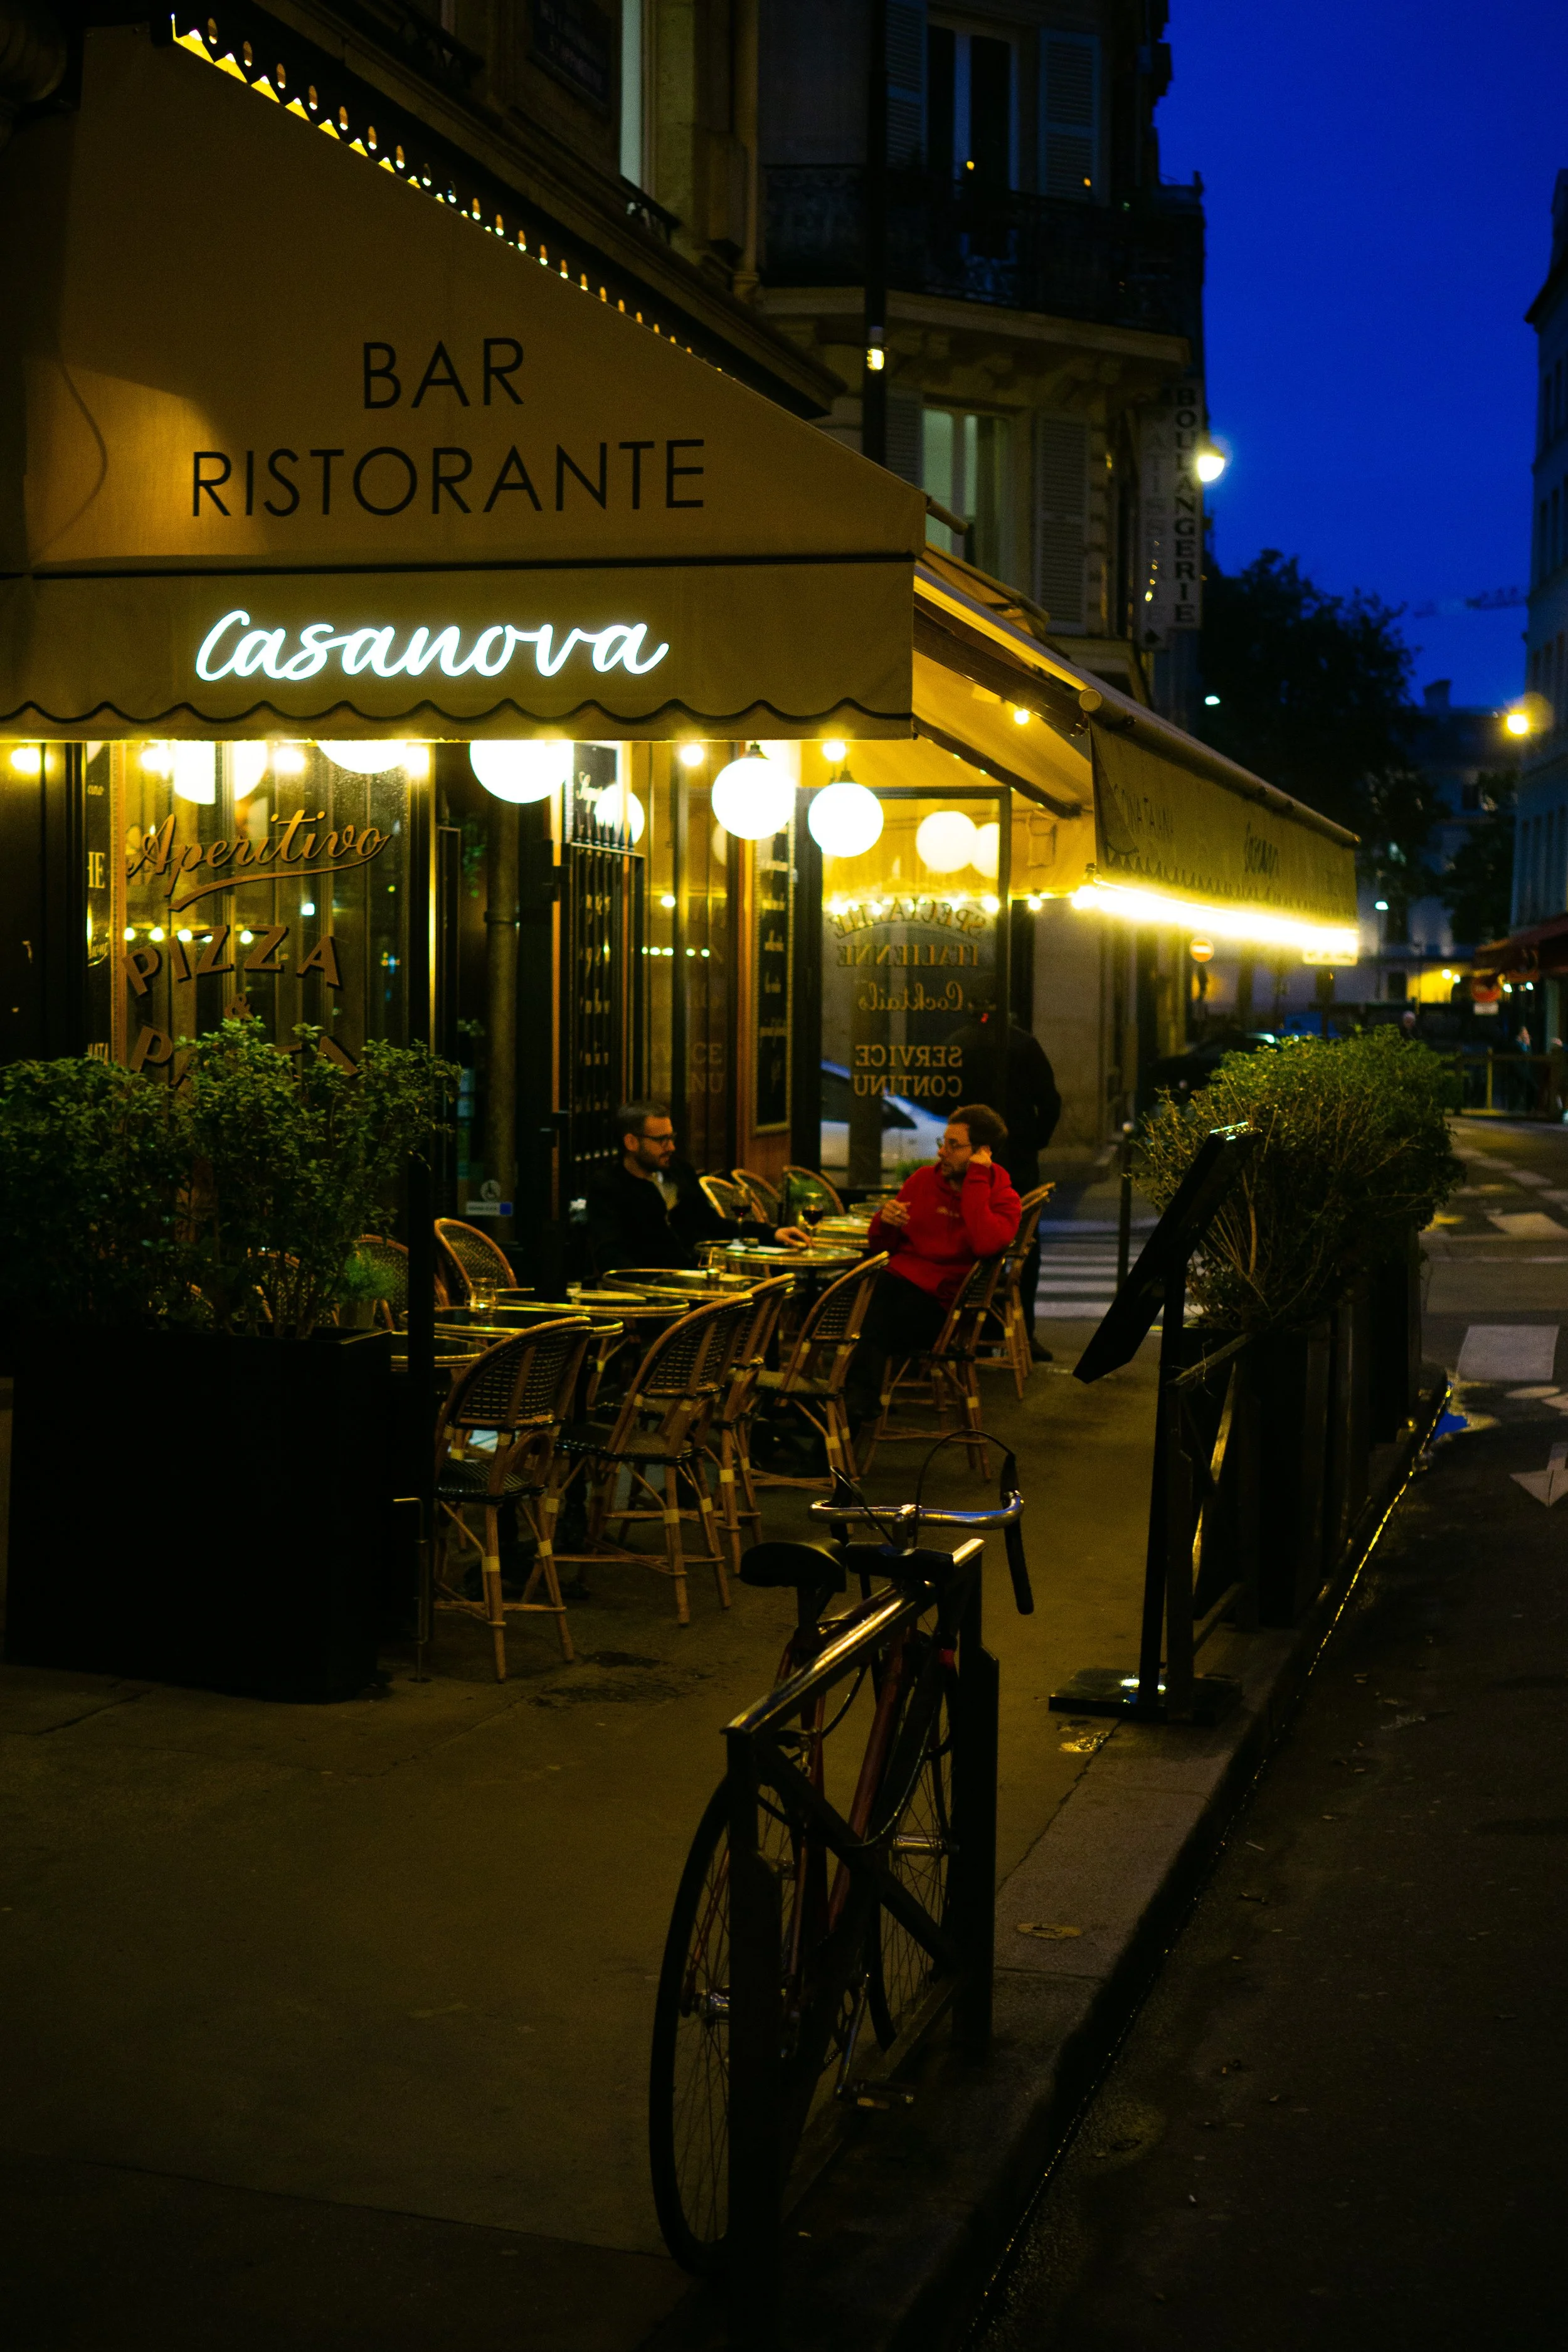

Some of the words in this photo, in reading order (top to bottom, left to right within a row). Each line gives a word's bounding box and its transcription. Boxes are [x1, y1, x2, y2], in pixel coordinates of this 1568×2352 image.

[363, 337, 524, 410] BAR
[192, 438, 705, 517] RISTORANTE
[194, 609, 670, 682] Casanova
[127, 809, 393, 897] Aperitivo
[122, 925, 342, 998] PIZZA
[223, 993, 255, 1020] &
